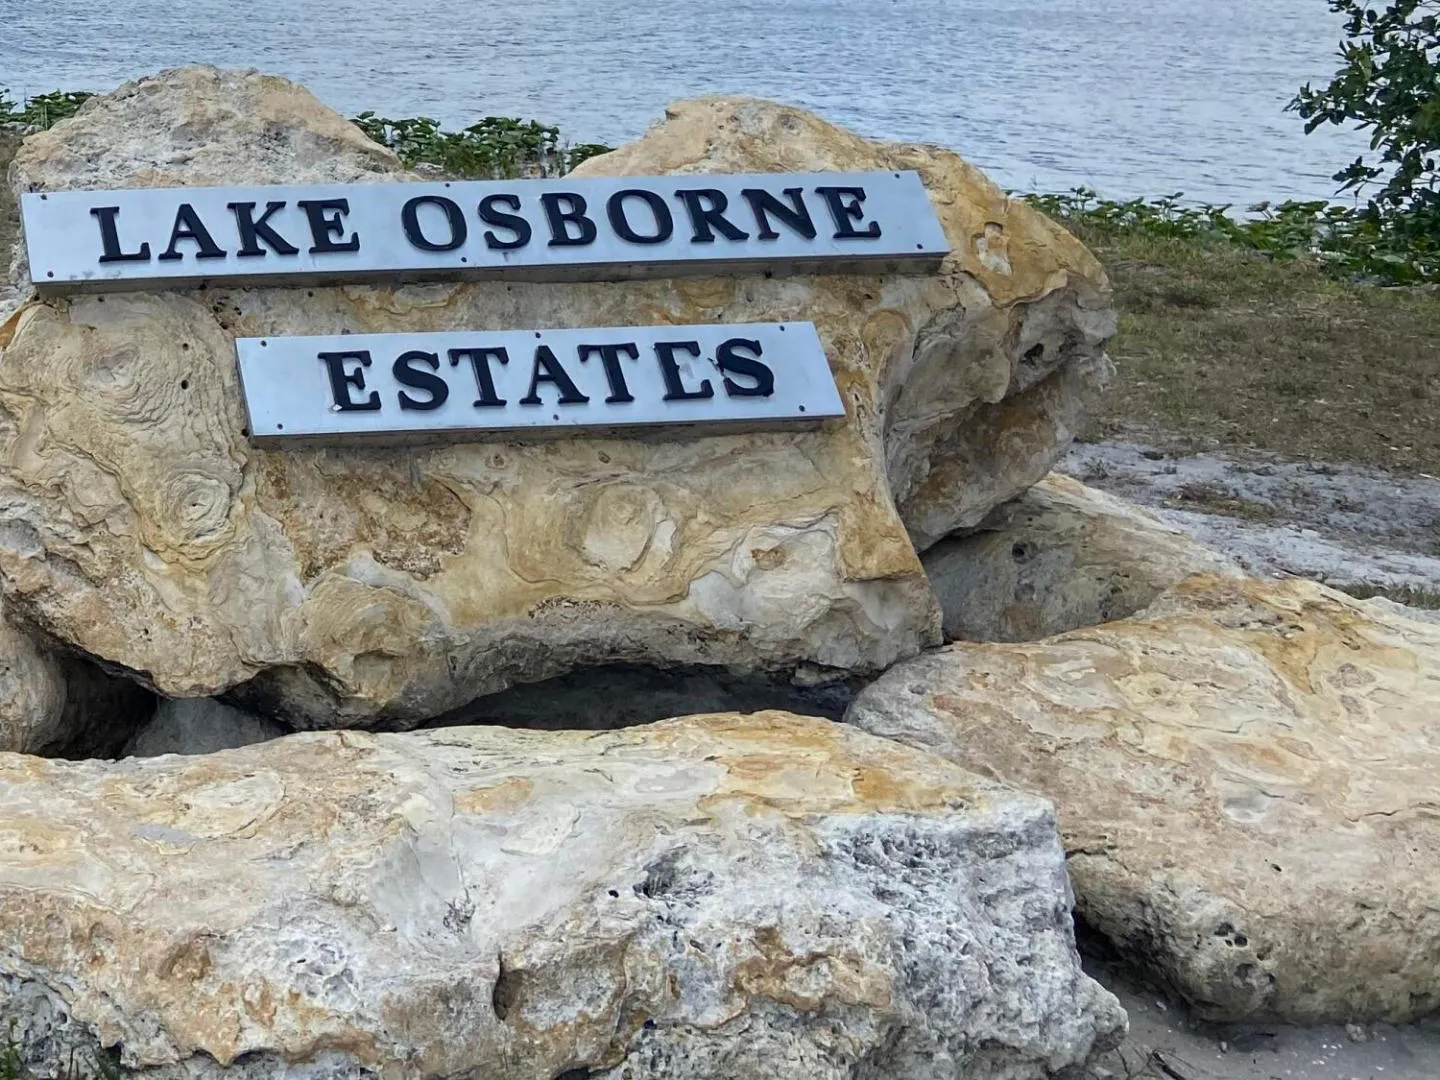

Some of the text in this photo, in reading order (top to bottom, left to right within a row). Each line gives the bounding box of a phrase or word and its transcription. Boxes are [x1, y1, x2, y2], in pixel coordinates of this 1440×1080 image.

[90, 187, 882, 262] LAKE OSBORNE
[318, 338, 775, 411] ESTATES
